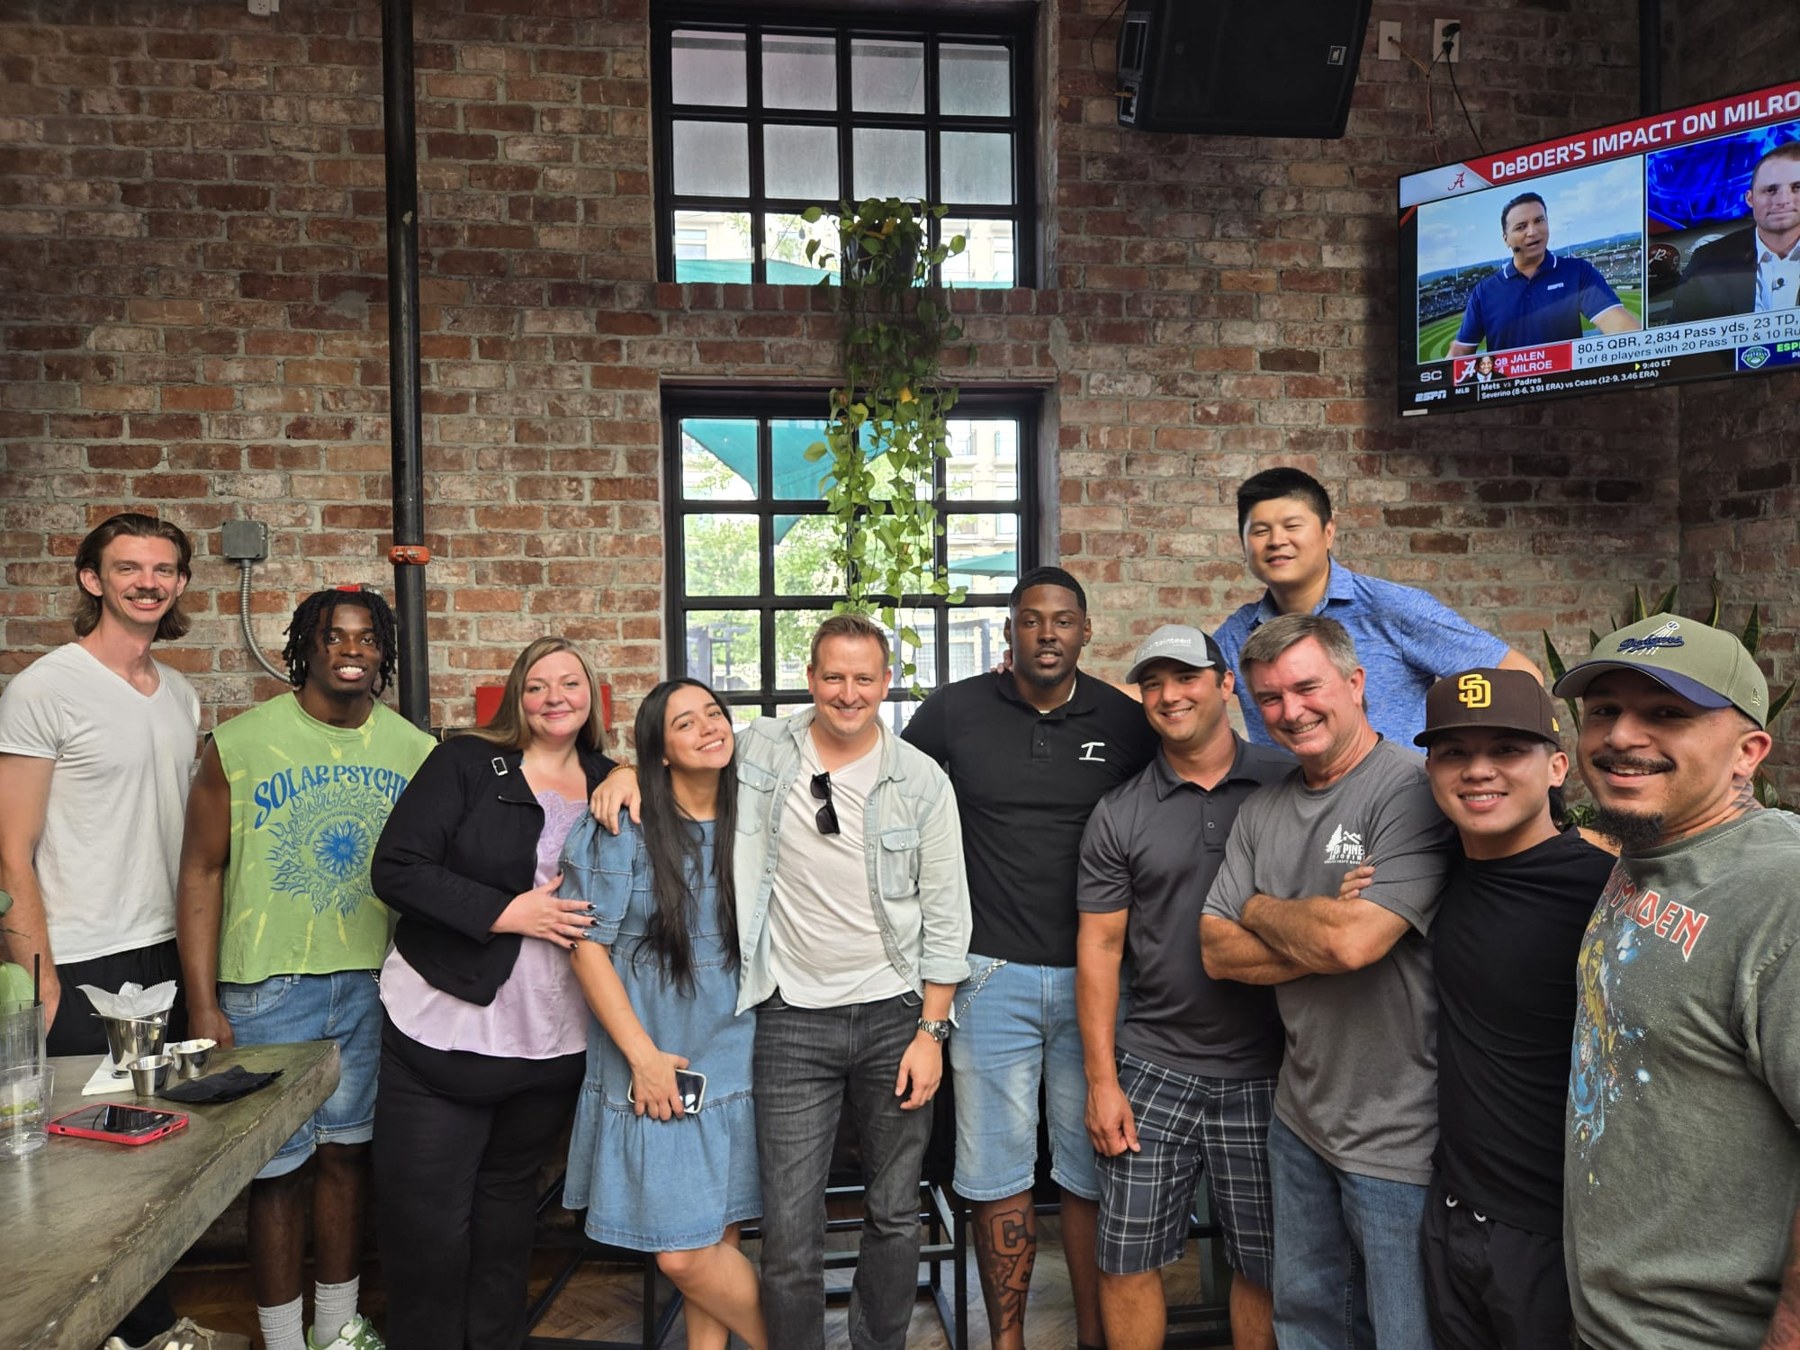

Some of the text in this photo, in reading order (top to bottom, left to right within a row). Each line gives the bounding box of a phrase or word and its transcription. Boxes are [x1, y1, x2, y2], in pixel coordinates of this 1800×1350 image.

[1492, 90, 1800, 180] DeBOER'S IMPACT ON MILRO
[1577, 341, 1604, 354] 80.5
[1607, 336, 1641, 350] QBR,
[1644, 330, 1680, 345] 2,834
[1684, 326, 1717, 339] Pass
[1753, 317, 1771, 330] 23
[1774, 313, 1799, 326] TD,
[1587, 355, 1599, 365] of
[1601, 353, 1608, 362] 8
[1611, 346, 1652, 363] players
[1654, 343, 1679, 355] with
[1681, 341, 1696, 352] 20
[1699, 337, 1728, 349] Pass
[1732, 333, 1749, 344] TD
[1752, 333, 1761, 341] &
[1767, 329, 1780, 339] 10
[1776, 341, 1800, 353] ESP
[1510, 350, 1545, 364] JALEN
[1510, 360, 1553, 375] MILROE
[1641, 359, 1672, 370] 9:40 ET
[1420, 370, 1443, 382] SC
[1455, 386, 1470, 395] MLB
[1480, 382, 1501, 391] Mets
[1514, 377, 1542, 387] Padres
[1480, 389, 1511, 400] Severino
[1545, 381, 1564, 392] ERA)
[1574, 378, 1597, 388] Cease
[1639, 370, 1659, 379] ERA)
[1415, 389, 1447, 403] ESPN
[1458, 673, 1491, 709] SD
[254, 765, 330, 830] SOLAR
